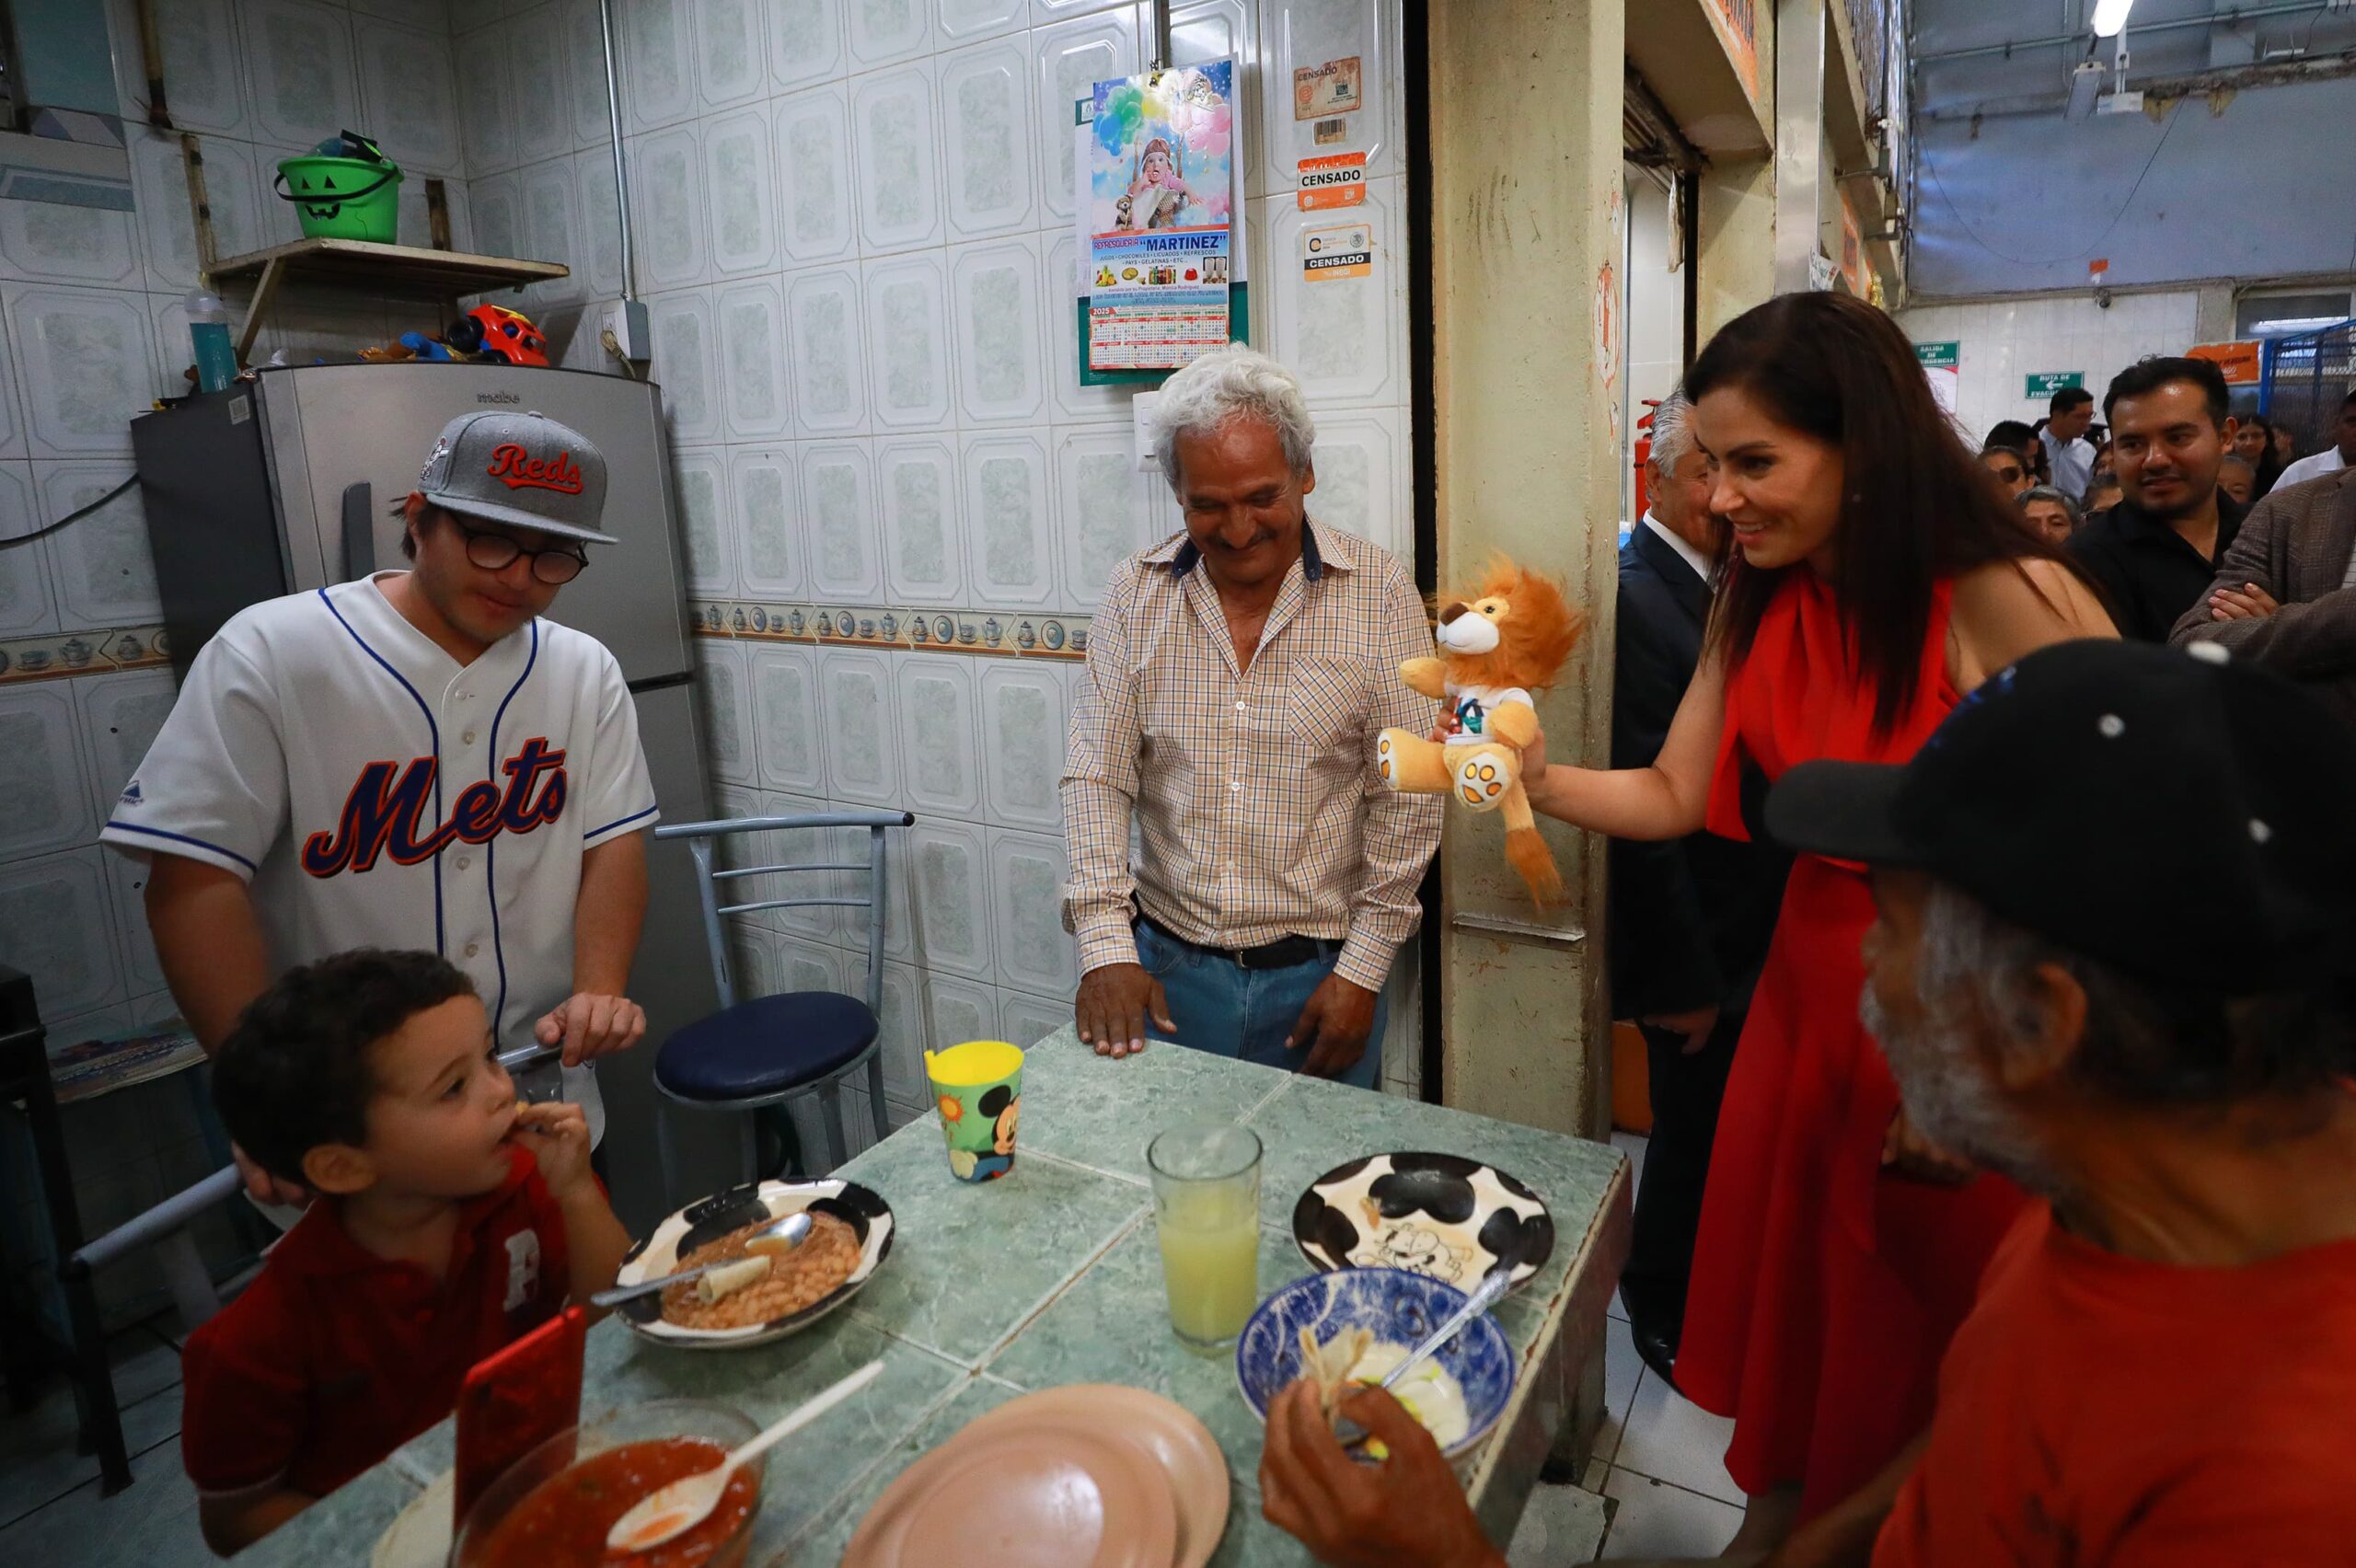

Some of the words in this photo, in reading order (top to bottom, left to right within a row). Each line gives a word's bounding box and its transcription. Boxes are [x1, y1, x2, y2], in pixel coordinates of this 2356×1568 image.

[1298, 66, 1337, 81] CENSADO
[1301, 169, 1361, 187] CENSADO
[1309, 254, 1365, 268] CENSADO
[477, 390, 520, 404] mabe
[487, 443, 583, 495] Reds
[302, 737, 568, 879] Mets
